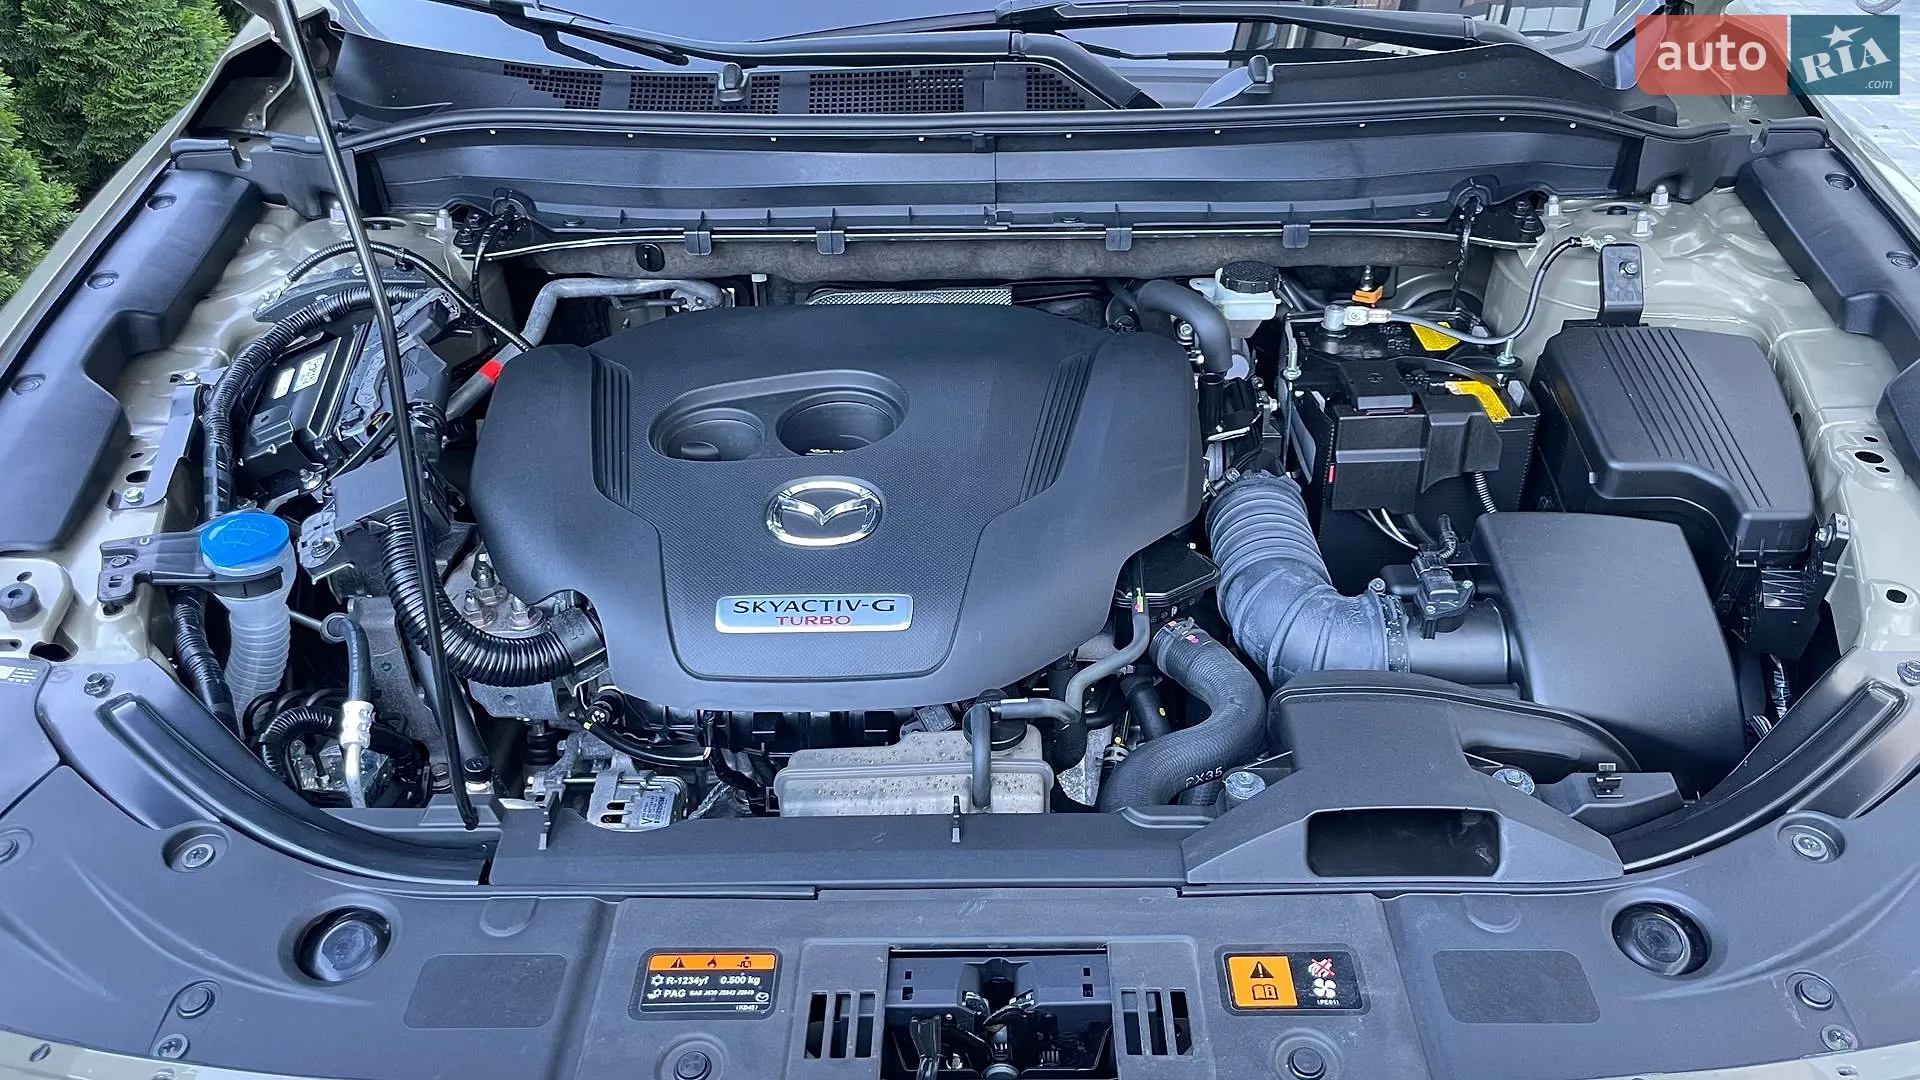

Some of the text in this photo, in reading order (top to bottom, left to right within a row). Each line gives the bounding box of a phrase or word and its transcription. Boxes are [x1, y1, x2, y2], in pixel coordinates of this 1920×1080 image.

[733, 599, 895, 614] SKYACTIV-G
[776, 615, 852, 626] TURBO
[666, 976, 710, 987] R-1234yf
[748, 976, 761, 986] kg
[664, 989, 687, 998] PAG
